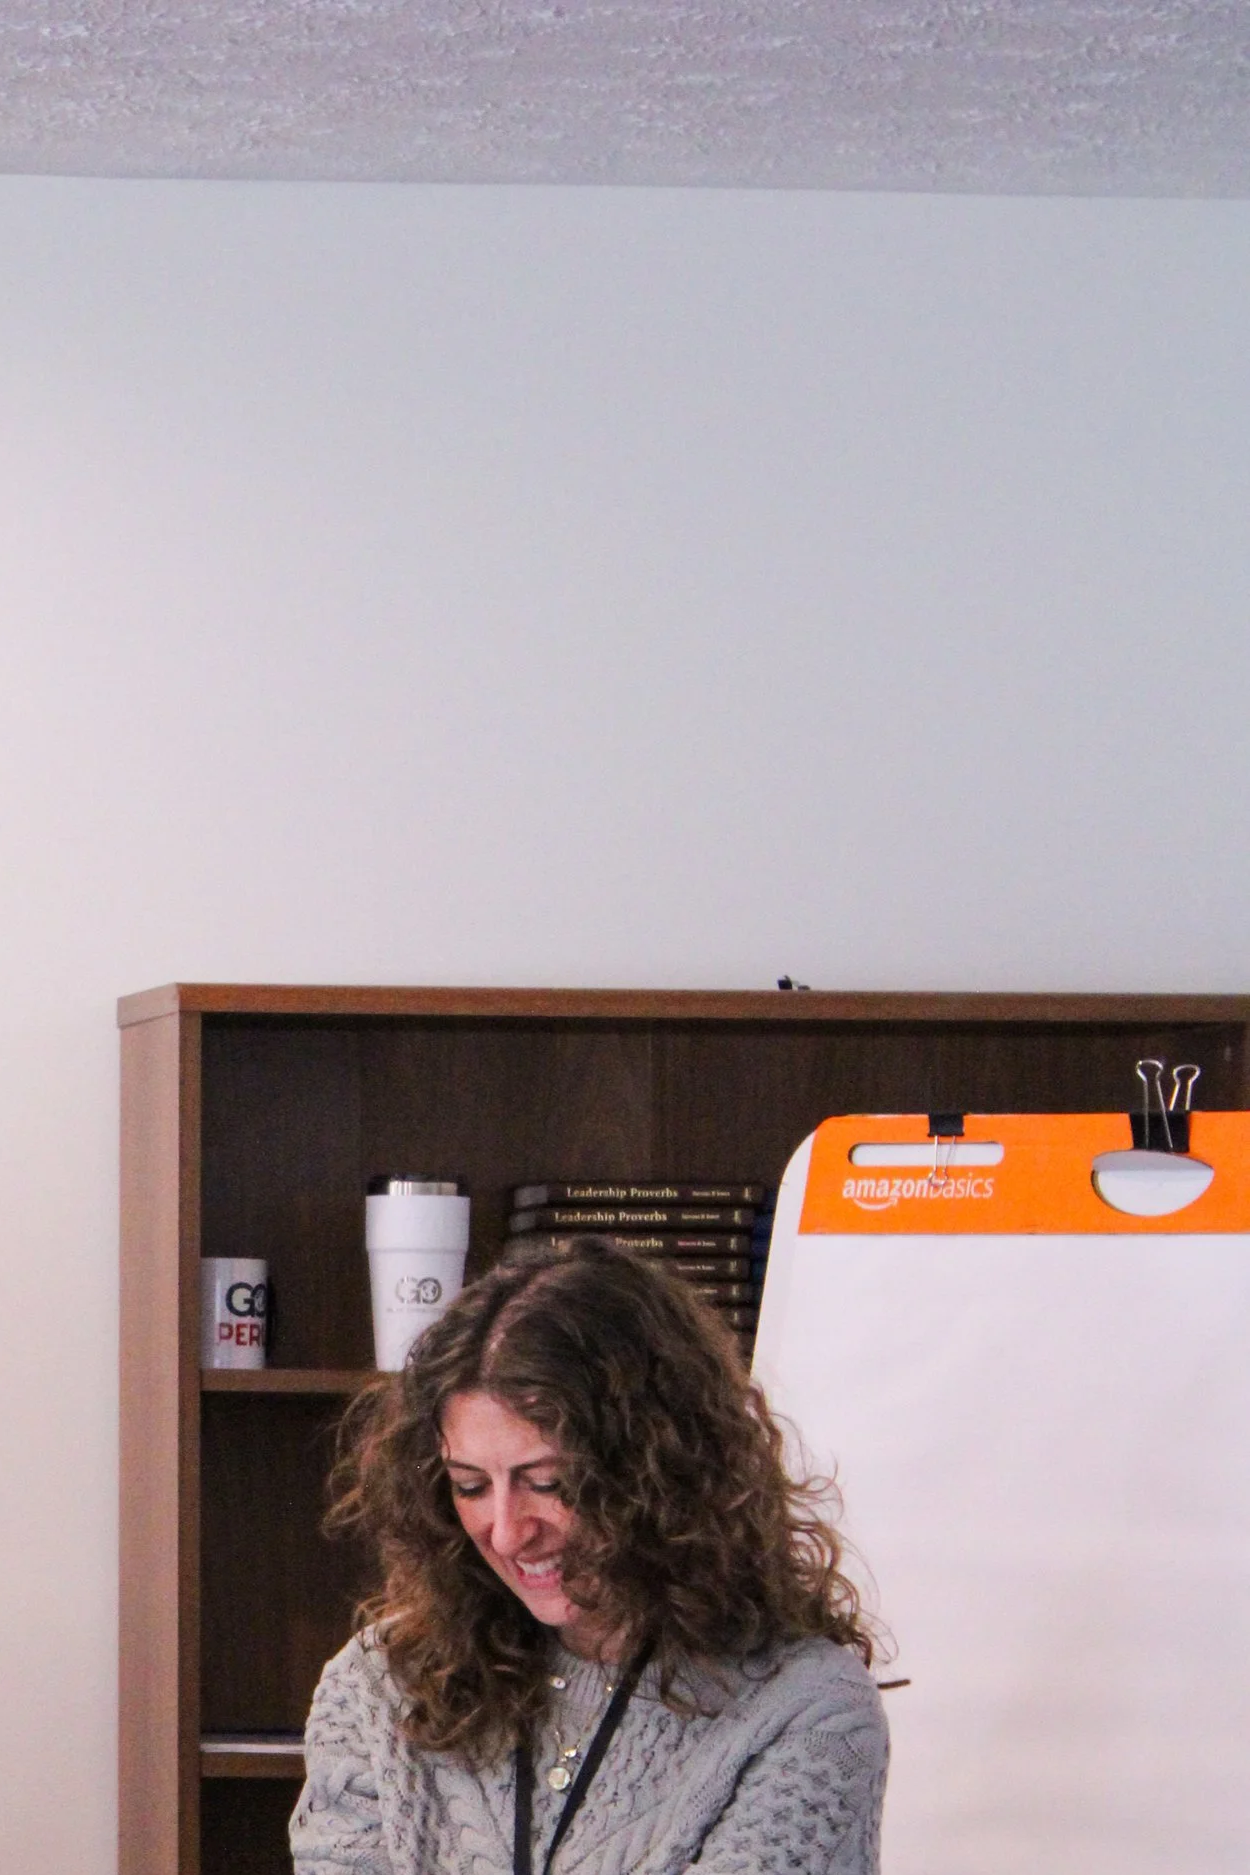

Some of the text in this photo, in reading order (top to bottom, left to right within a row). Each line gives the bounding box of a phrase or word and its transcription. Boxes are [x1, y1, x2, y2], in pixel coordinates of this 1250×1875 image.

[566, 1187, 627, 1199] Leadership
[630, 1187, 679, 1198] Proverbs
[554, 1211, 616, 1225] Leadership
[618, 1211, 668, 1222] Proverbs
[614, 1237, 665, 1248] Proverbs
